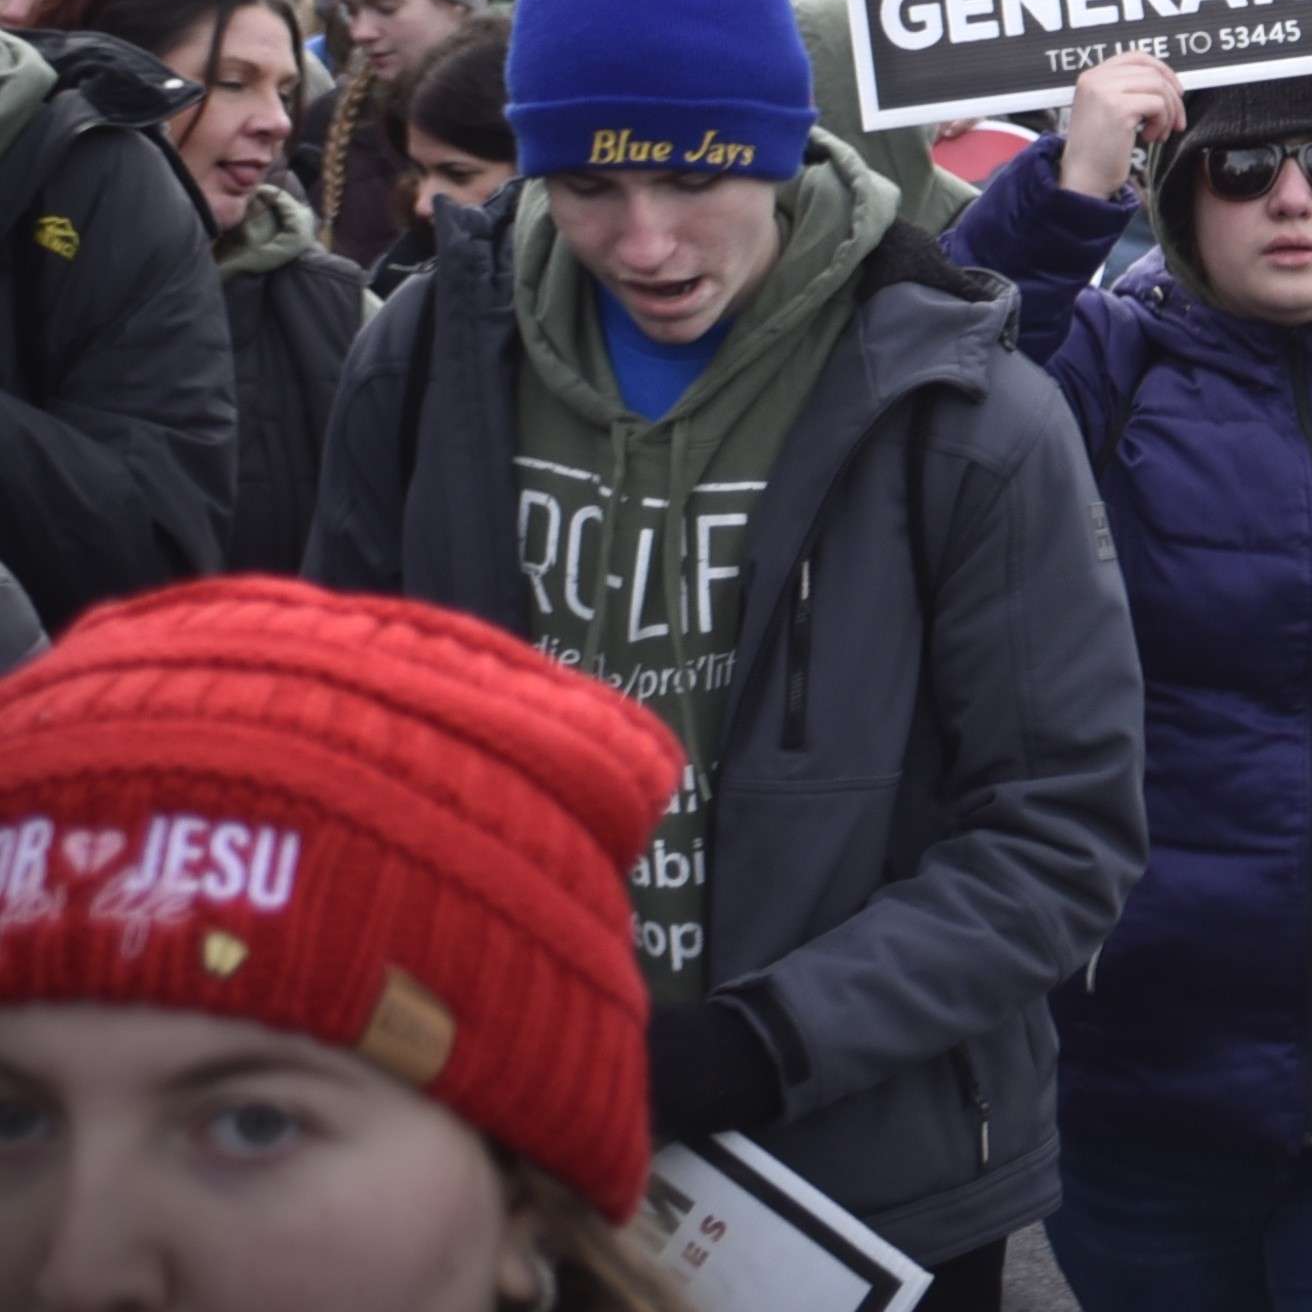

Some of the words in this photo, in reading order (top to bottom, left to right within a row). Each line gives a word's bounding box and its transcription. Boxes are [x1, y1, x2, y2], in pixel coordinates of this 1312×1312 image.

[1044, 41, 1109, 74] TEXT
[1176, 30, 1213, 55] TO
[1219, 19, 1302, 51] 53445
[588, 128, 673, 165] Blue
[684, 129, 756, 170] Jays
